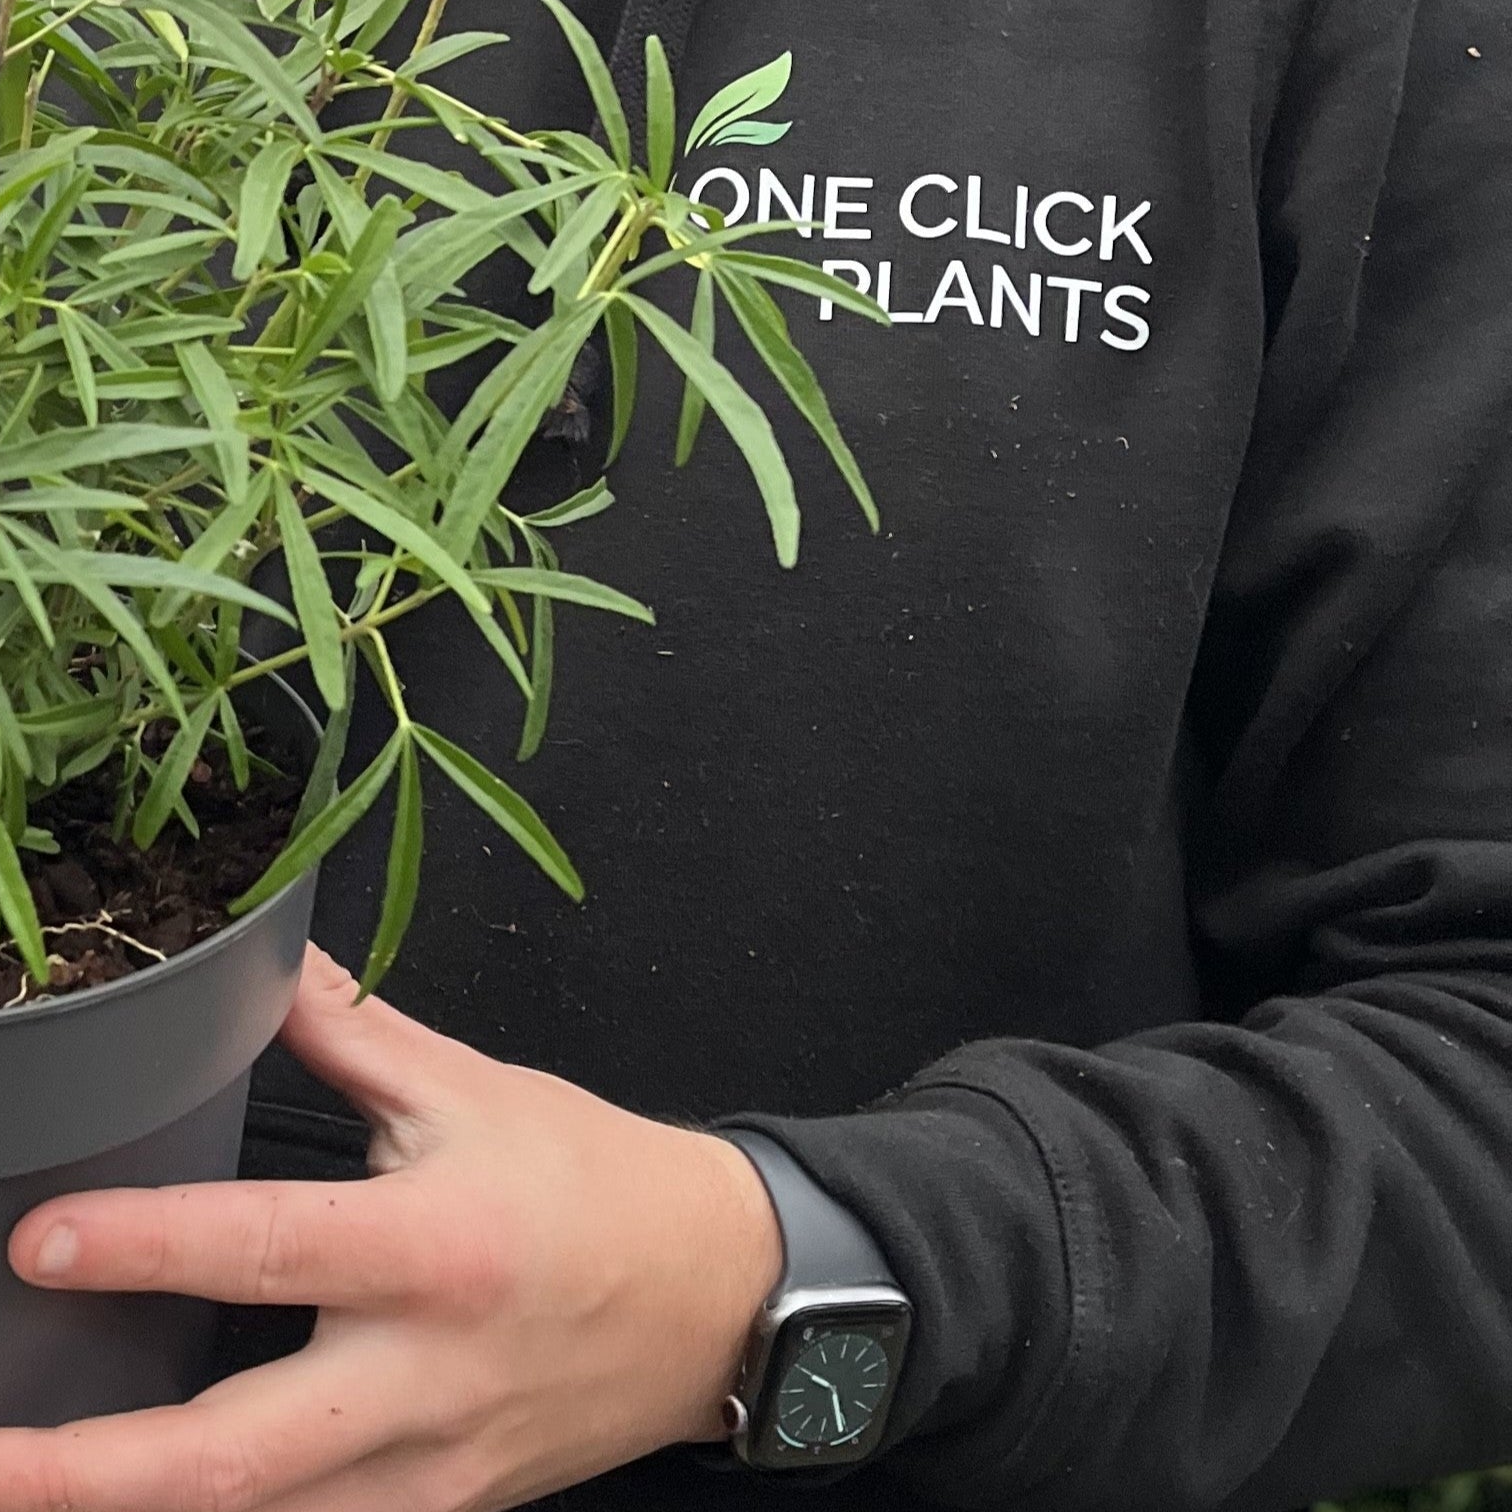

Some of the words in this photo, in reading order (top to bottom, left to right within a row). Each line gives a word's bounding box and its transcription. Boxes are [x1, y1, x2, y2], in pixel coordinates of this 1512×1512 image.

[689, 167, 874, 240] ONE
[899, 173, 1153, 265] CLICK
[819, 259, 1151, 352] PLANTS
